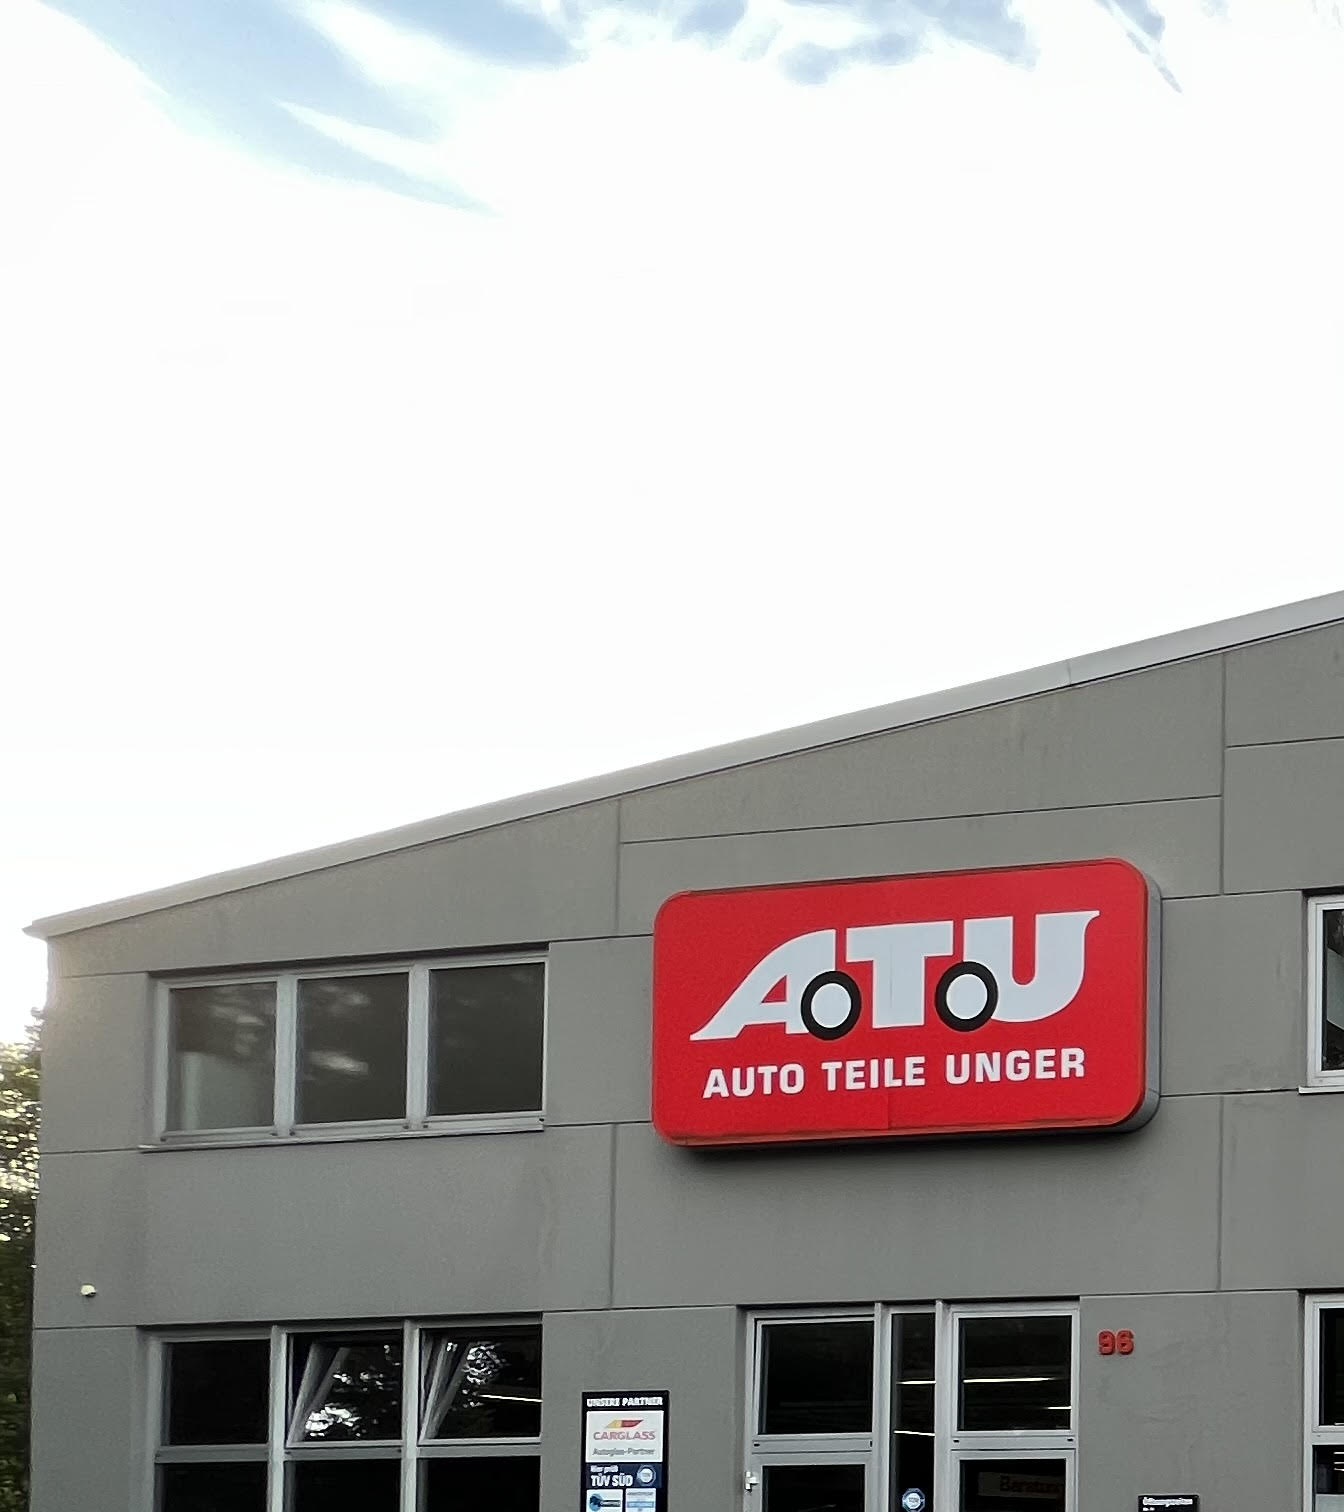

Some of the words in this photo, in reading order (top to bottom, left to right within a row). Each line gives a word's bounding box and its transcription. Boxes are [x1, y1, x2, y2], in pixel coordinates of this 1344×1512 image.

[690, 910, 1100, 1040] ATU
[702, 1063, 805, 1099] AUTO
[821, 1056, 926, 1092] TEILE
[945, 1047, 1085, 1085] UNGER
[1098, 1329, 1134, 1356] 96
[593, 1431, 656, 1441] CARGLASS
[590, 1472, 611, 1487] TÜV
[611, 1472, 634, 1487] SÜD
